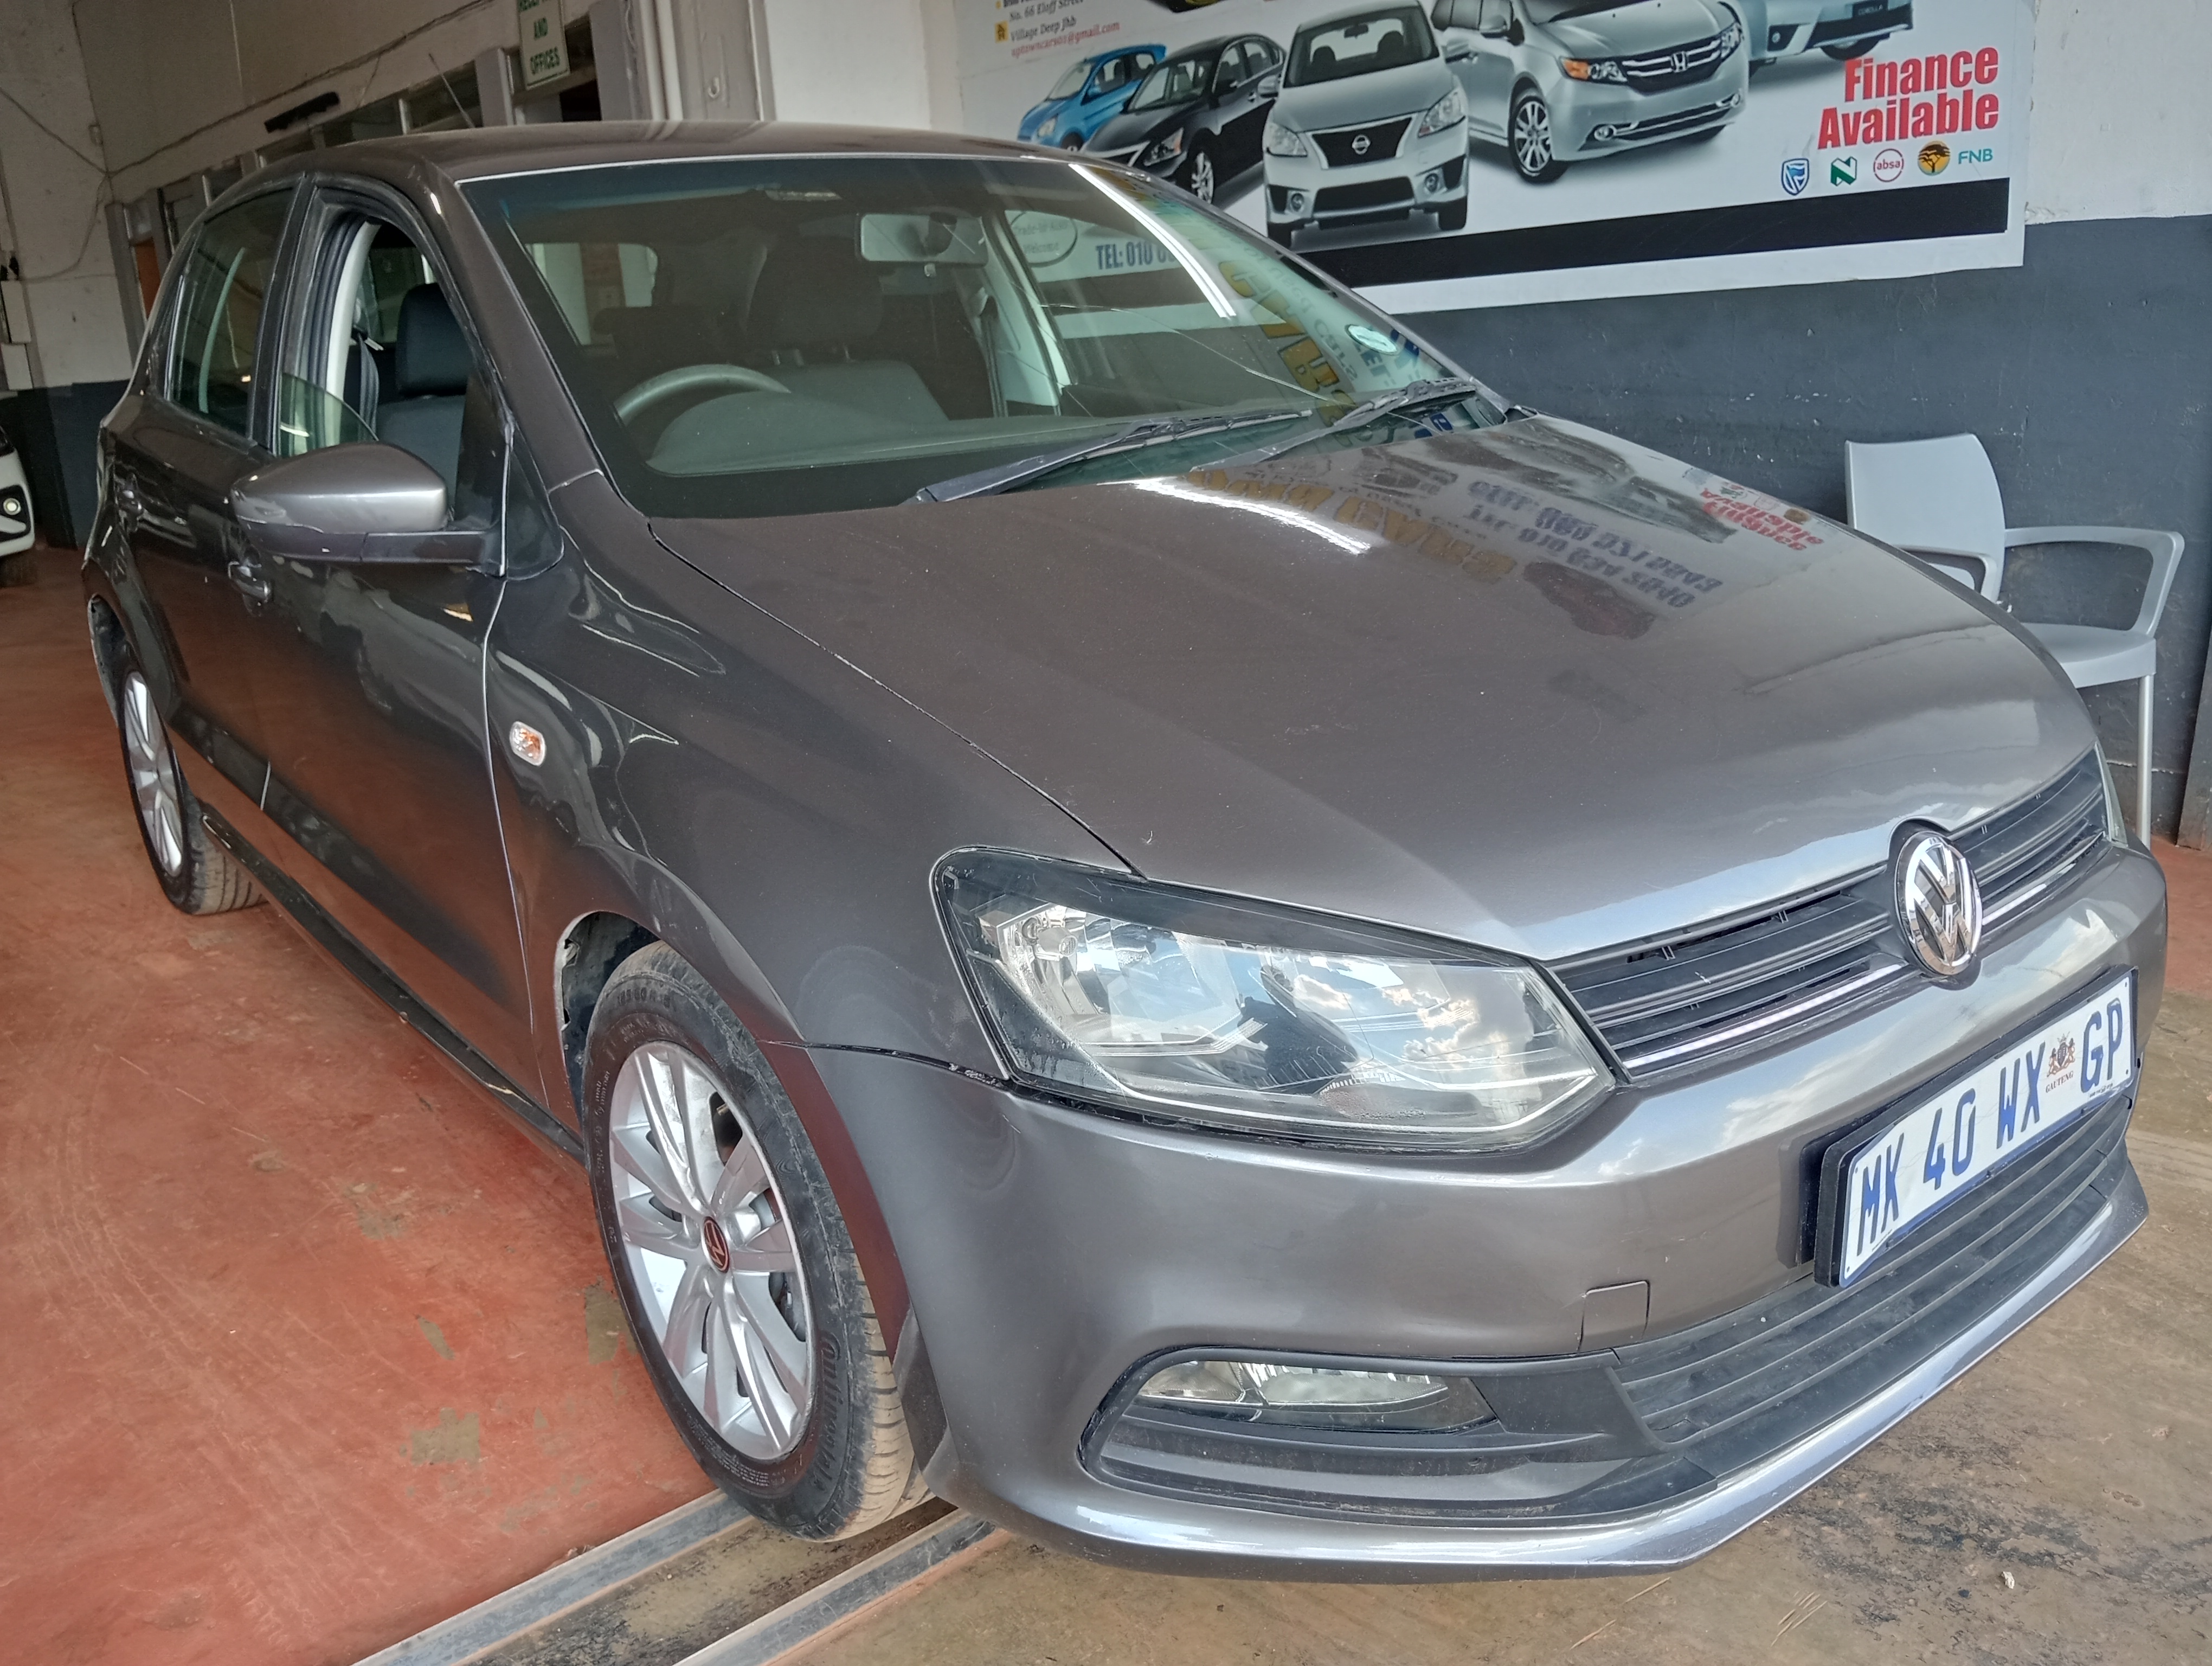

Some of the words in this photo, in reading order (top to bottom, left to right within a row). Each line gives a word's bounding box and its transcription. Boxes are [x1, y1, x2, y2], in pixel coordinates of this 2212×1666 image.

[1844, 47, 1998, 102] Finance
[1818, 89, 1999, 149] Available
[1876, 159, 1900, 170] absa
[1958, 148, 1993, 164] FNB
[1095, 244, 1124, 270] TEL:
[1126, 241, 1153, 267] 010
[2046, 1070, 2074, 1093] GAUTENG
[1856, 1132, 1905, 1257] MK
[1923, 1087, 1976, 1190] 40
[1996, 1041, 2046, 1150] WX
[2080, 997, 2124, 1094] GP
